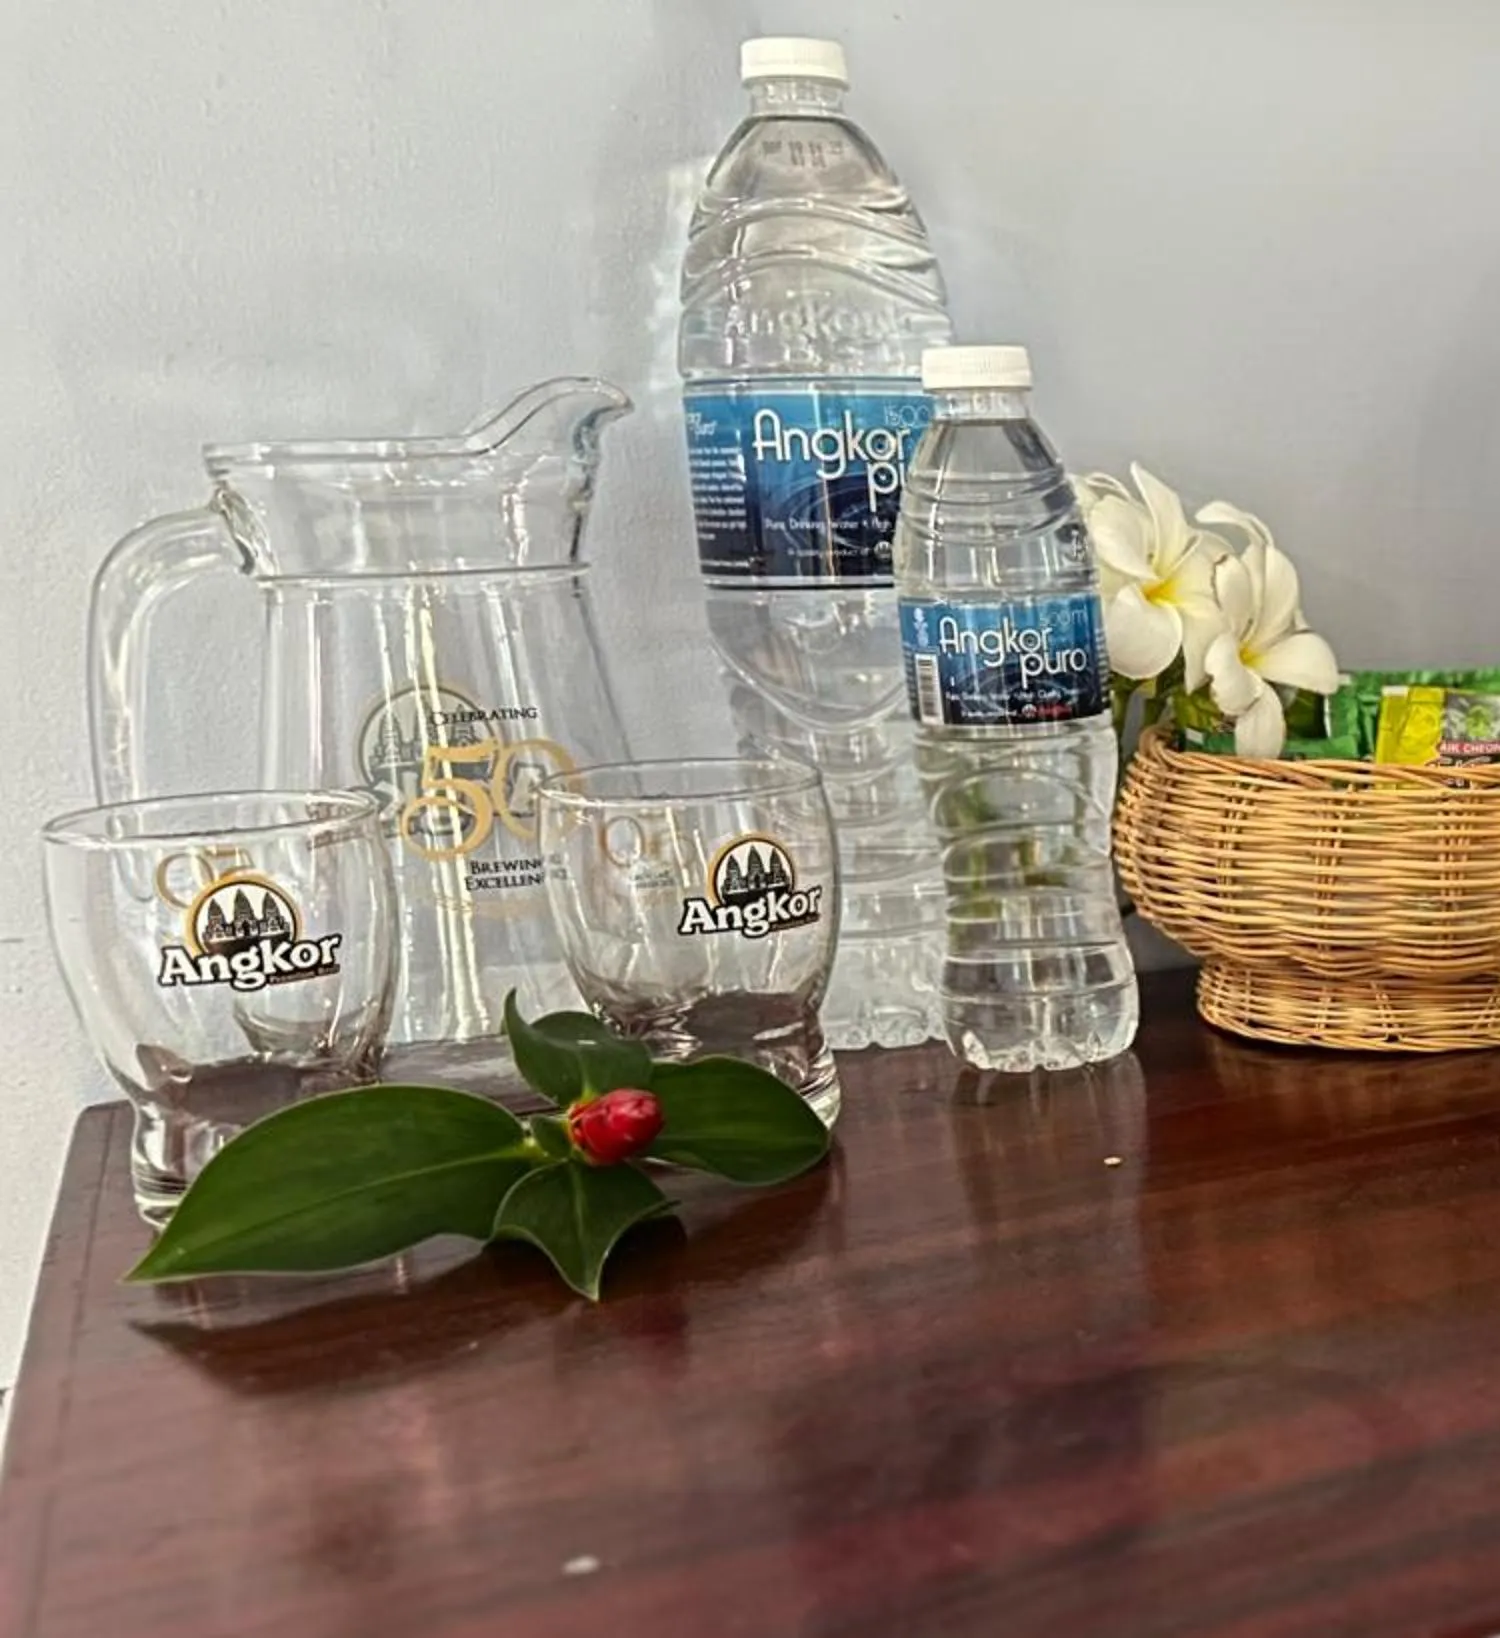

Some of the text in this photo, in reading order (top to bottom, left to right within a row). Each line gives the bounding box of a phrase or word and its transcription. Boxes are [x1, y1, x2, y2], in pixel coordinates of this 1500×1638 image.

[752, 408, 911, 480] Angkor
[939, 617, 1053, 667] Angkor
[1019, 647, 1087, 689] puro
[429, 707, 538, 726] CELEBRATING
[677, 885, 822, 939] Angkor
[158, 933, 342, 992] Angkor
